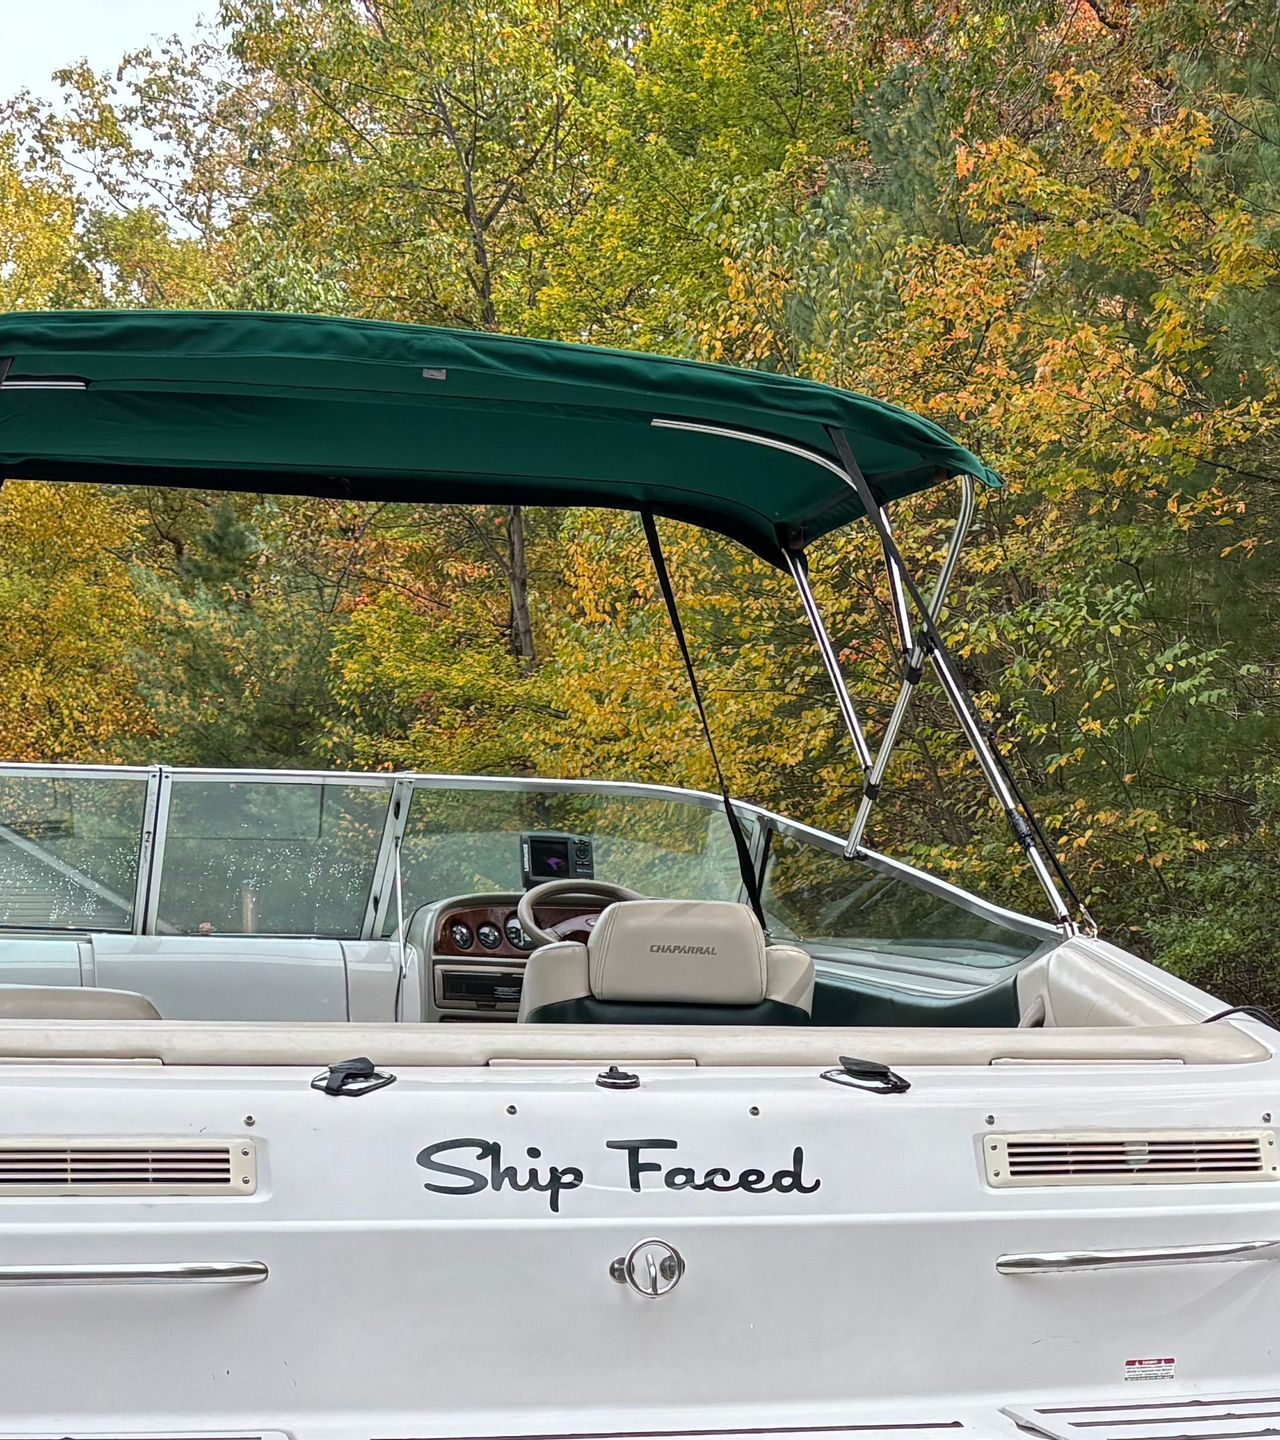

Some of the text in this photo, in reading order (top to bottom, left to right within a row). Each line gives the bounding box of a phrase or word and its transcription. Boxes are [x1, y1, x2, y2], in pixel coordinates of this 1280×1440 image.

[649, 944, 718, 956] CHAPARRAL
[416, 1137, 820, 1213] Ship Faced
